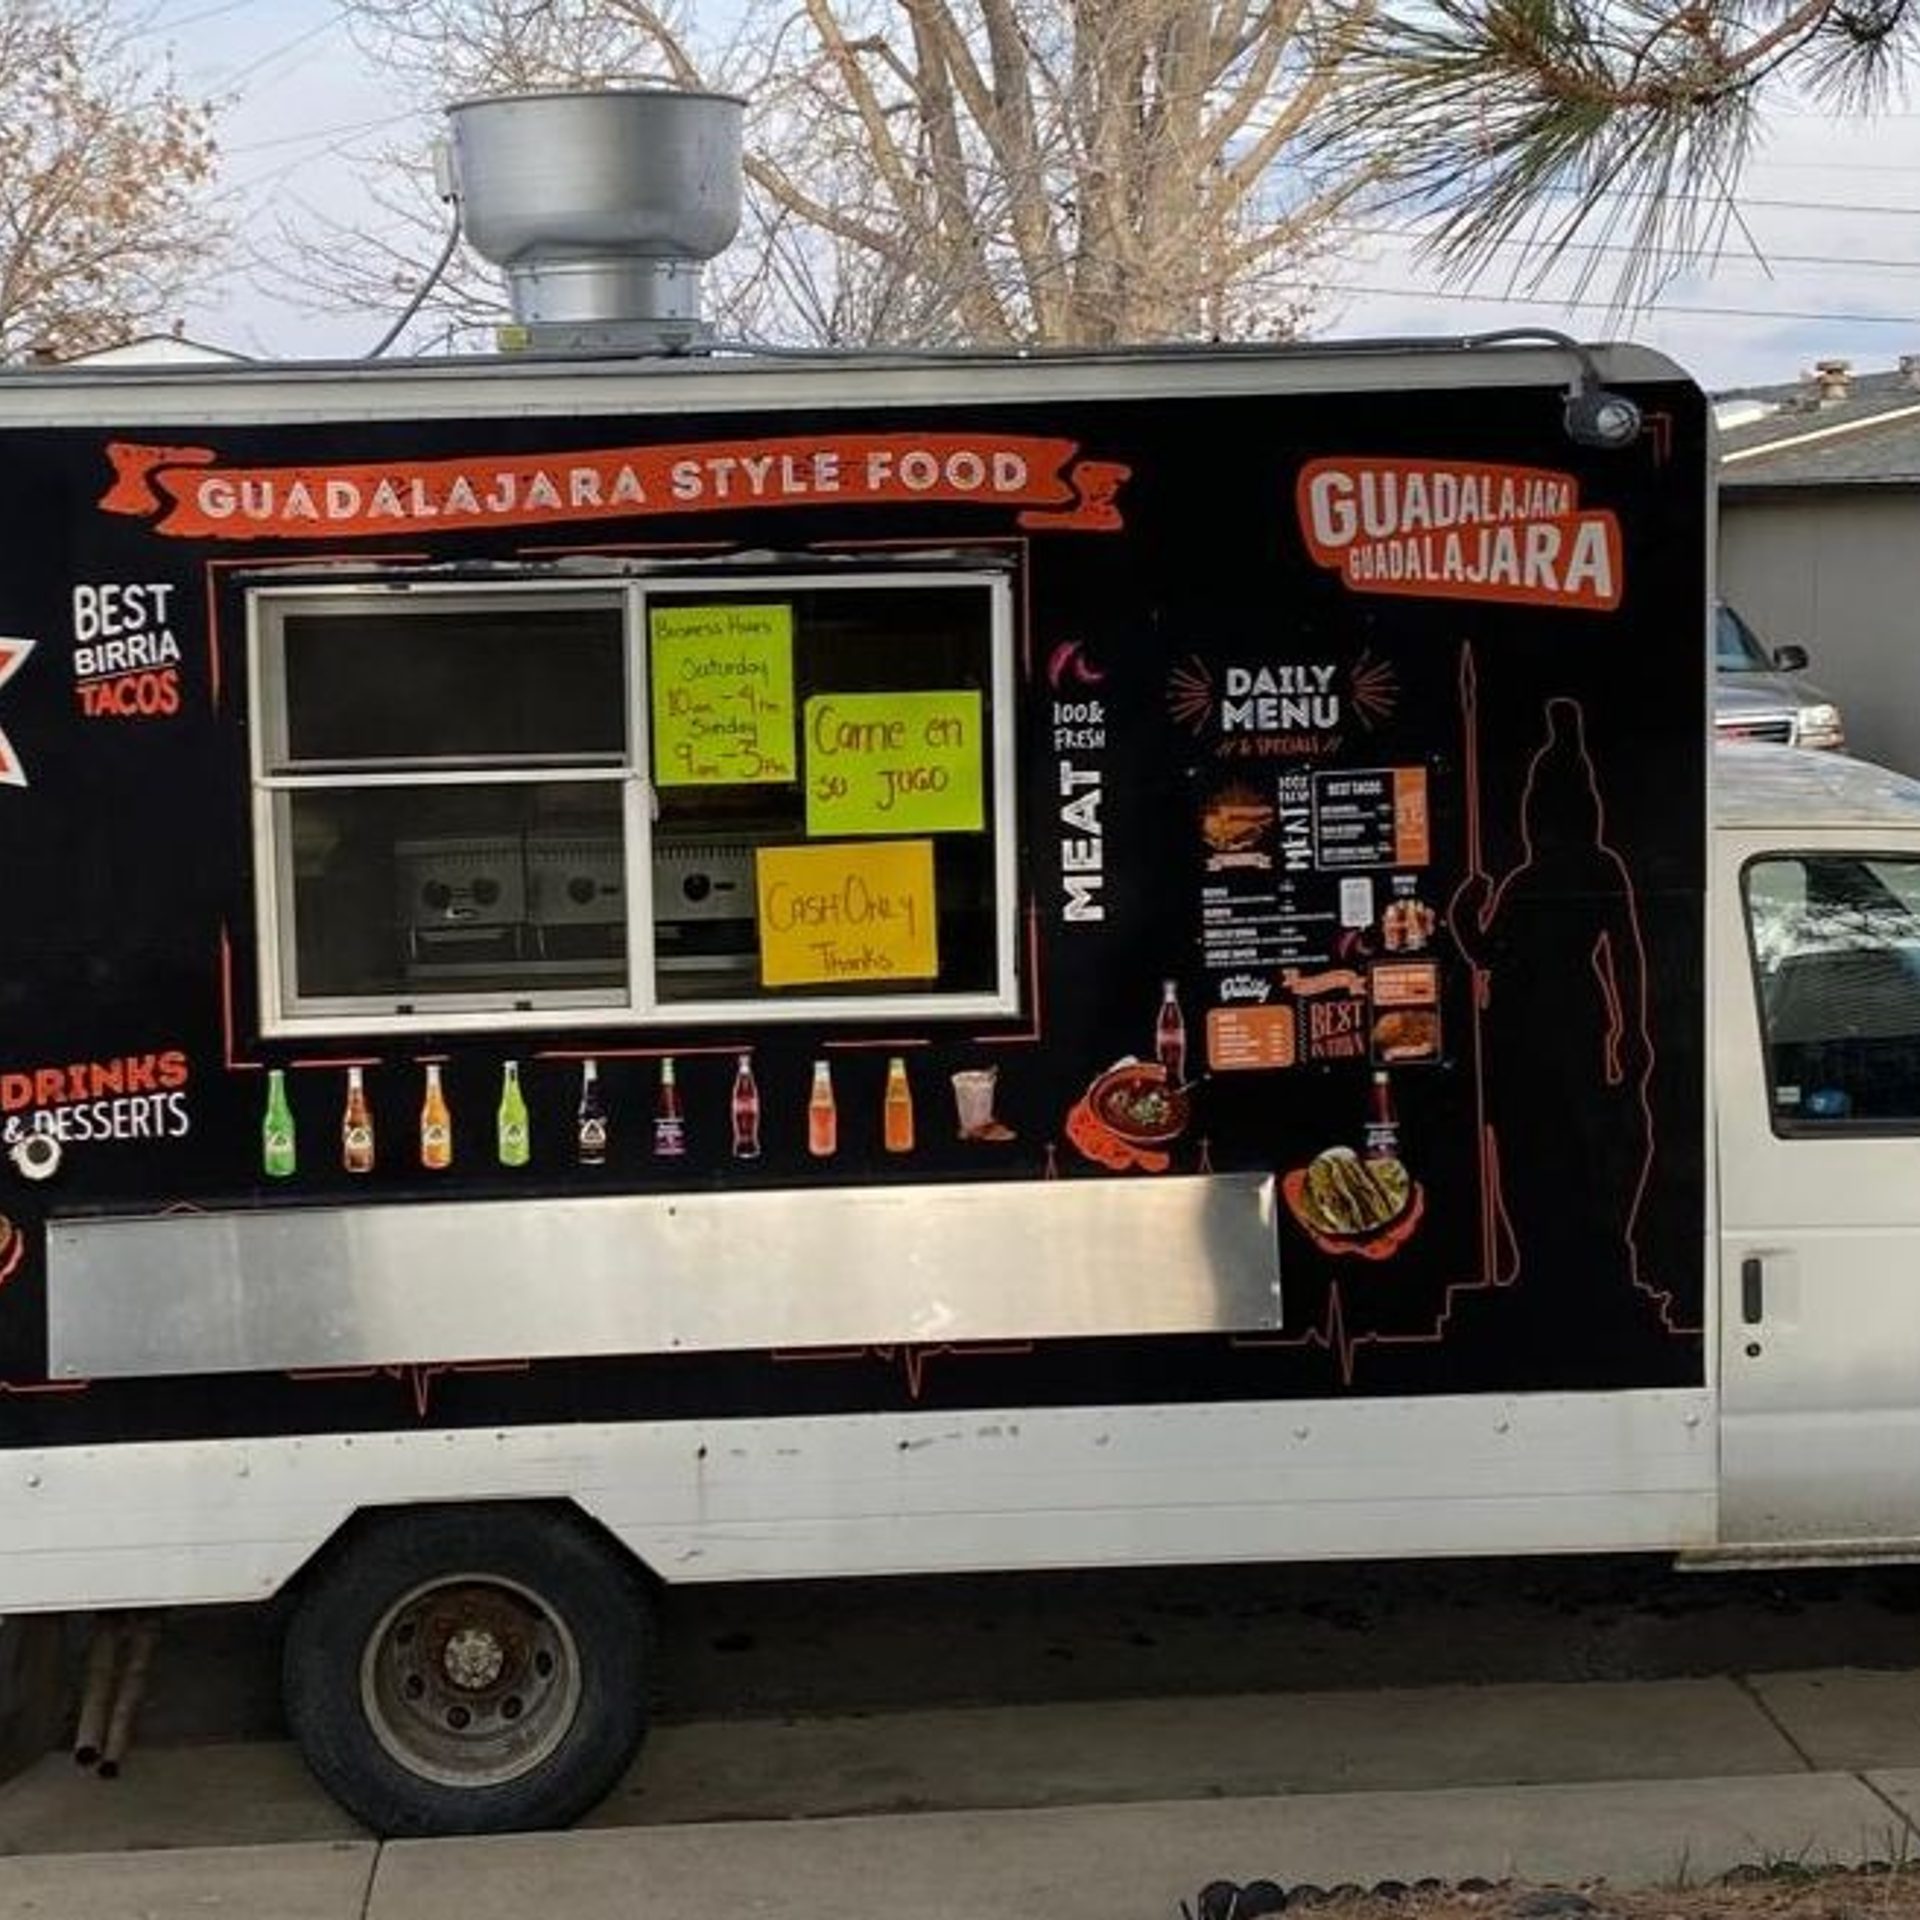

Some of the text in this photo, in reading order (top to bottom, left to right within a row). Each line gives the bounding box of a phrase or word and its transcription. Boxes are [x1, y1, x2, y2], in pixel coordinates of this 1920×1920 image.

[197, 451, 1027, 520] GUADALAJARA STYLE FOOD
[1311, 470, 1571, 547] GUADALAJARA
[1350, 520, 1613, 598] GUADALAJARA
[73, 584, 174, 641] BEST
[74, 629, 181, 676] BIRRIA
[76, 669, 180, 716] TACOS
[1226, 665, 1337, 697] DAILY
[925, 715, 963, 748] en
[1221, 695, 1340, 731] MENU
[1053, 727, 1107, 752] FRESH
[1059, 759, 1105, 922] MEAT
[0, 1051, 189, 1111] DRINKS
[3, 1091, 190, 1143] & DESSERTS
